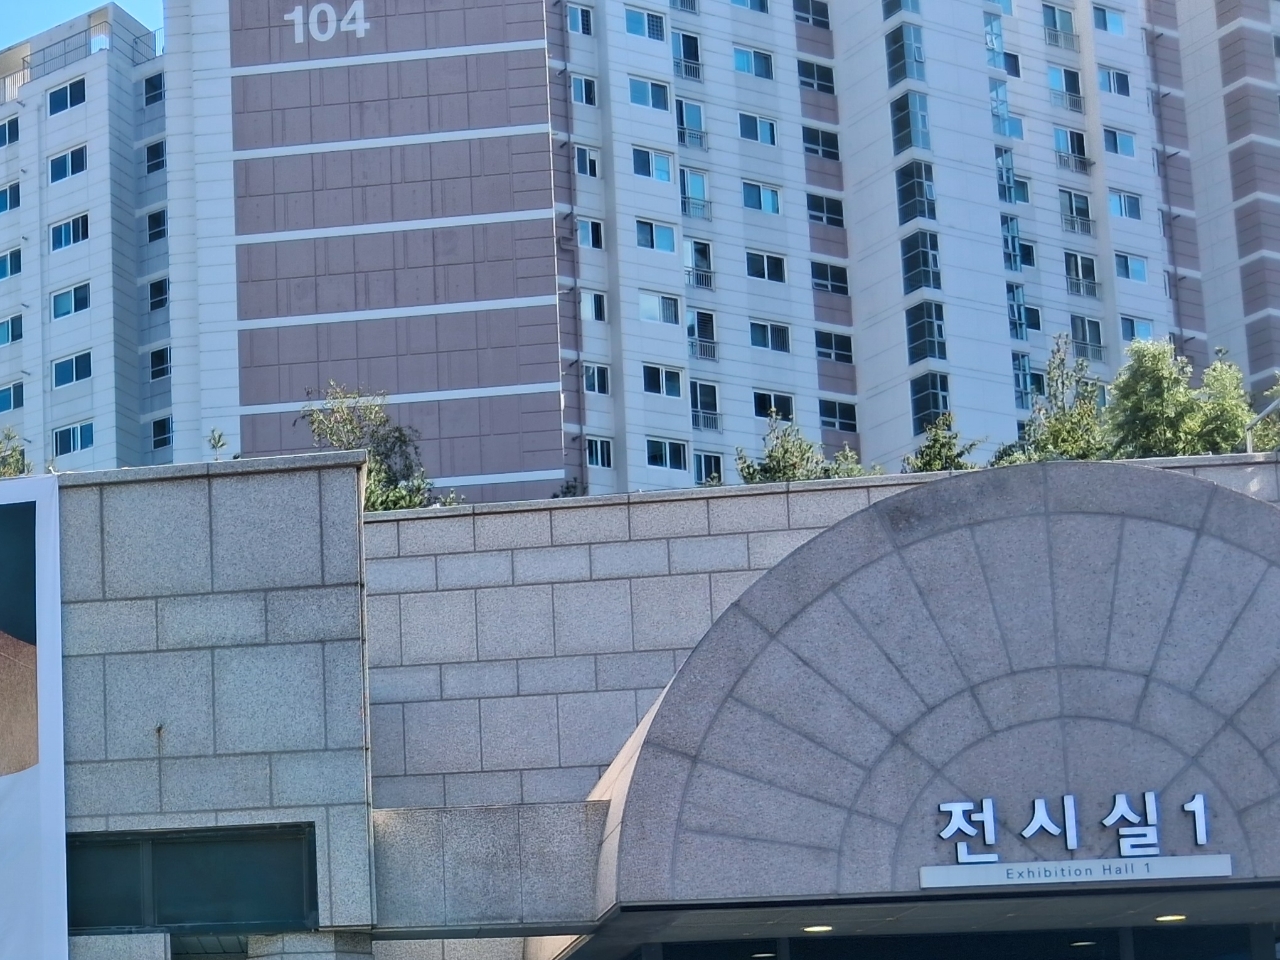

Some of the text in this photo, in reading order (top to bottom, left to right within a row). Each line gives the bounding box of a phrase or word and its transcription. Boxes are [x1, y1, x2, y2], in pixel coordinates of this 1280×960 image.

[284, 0, 370, 43] 104
[939, 791, 1207, 863] 전시실 1
[1006, 862, 1151, 880] Exhibition Hall 1
